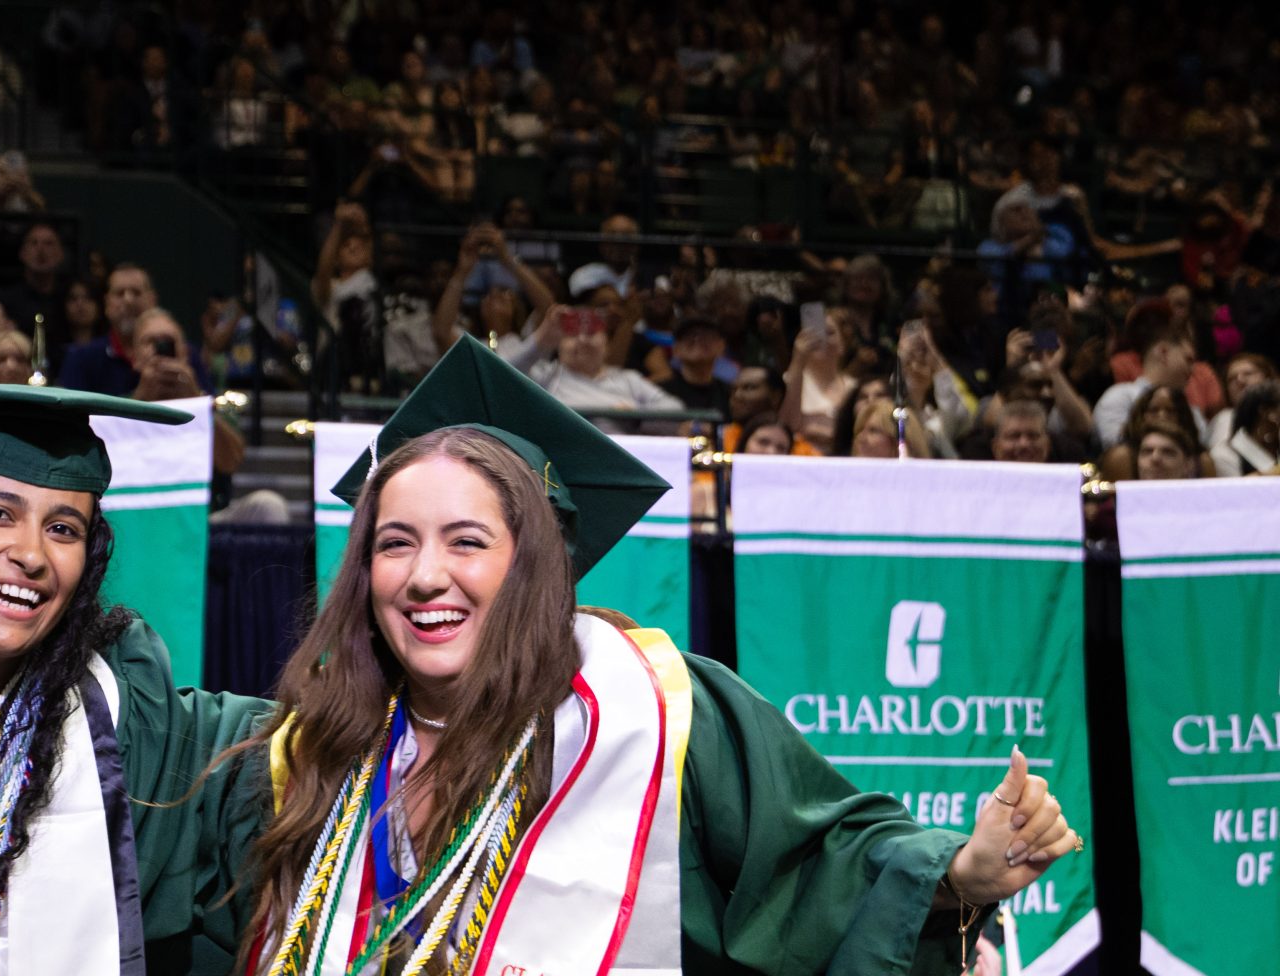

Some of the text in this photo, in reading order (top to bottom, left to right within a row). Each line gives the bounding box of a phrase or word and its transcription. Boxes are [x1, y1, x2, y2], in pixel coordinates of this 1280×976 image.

[784, 693, 1046, 737] CHARLOTTE
[890, 791, 967, 826] LEGE
[1236, 851, 1275, 887] OF
[999, 879, 1061, 916] IAL
